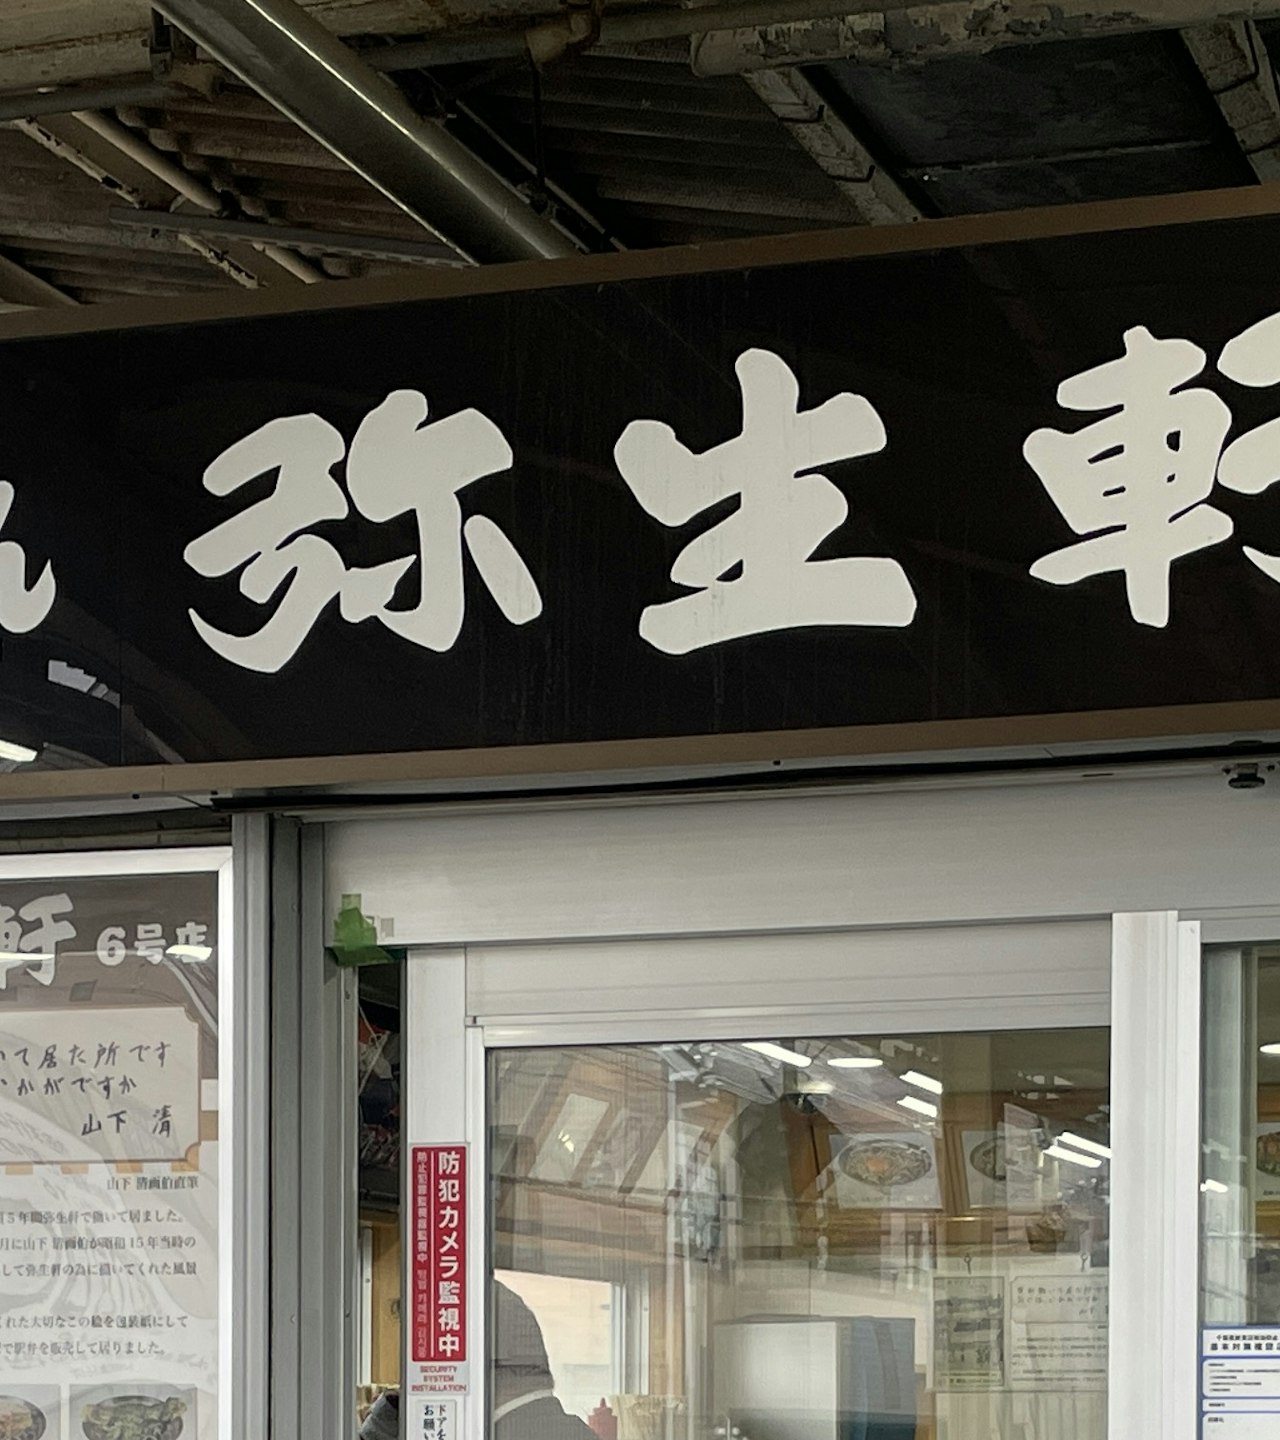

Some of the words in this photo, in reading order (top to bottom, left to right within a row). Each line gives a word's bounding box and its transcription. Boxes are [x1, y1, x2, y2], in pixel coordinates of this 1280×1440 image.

[81, 1110, 130, 1137] 山下
[438, 1151, 461, 1358] 防犯カメラ監視中
